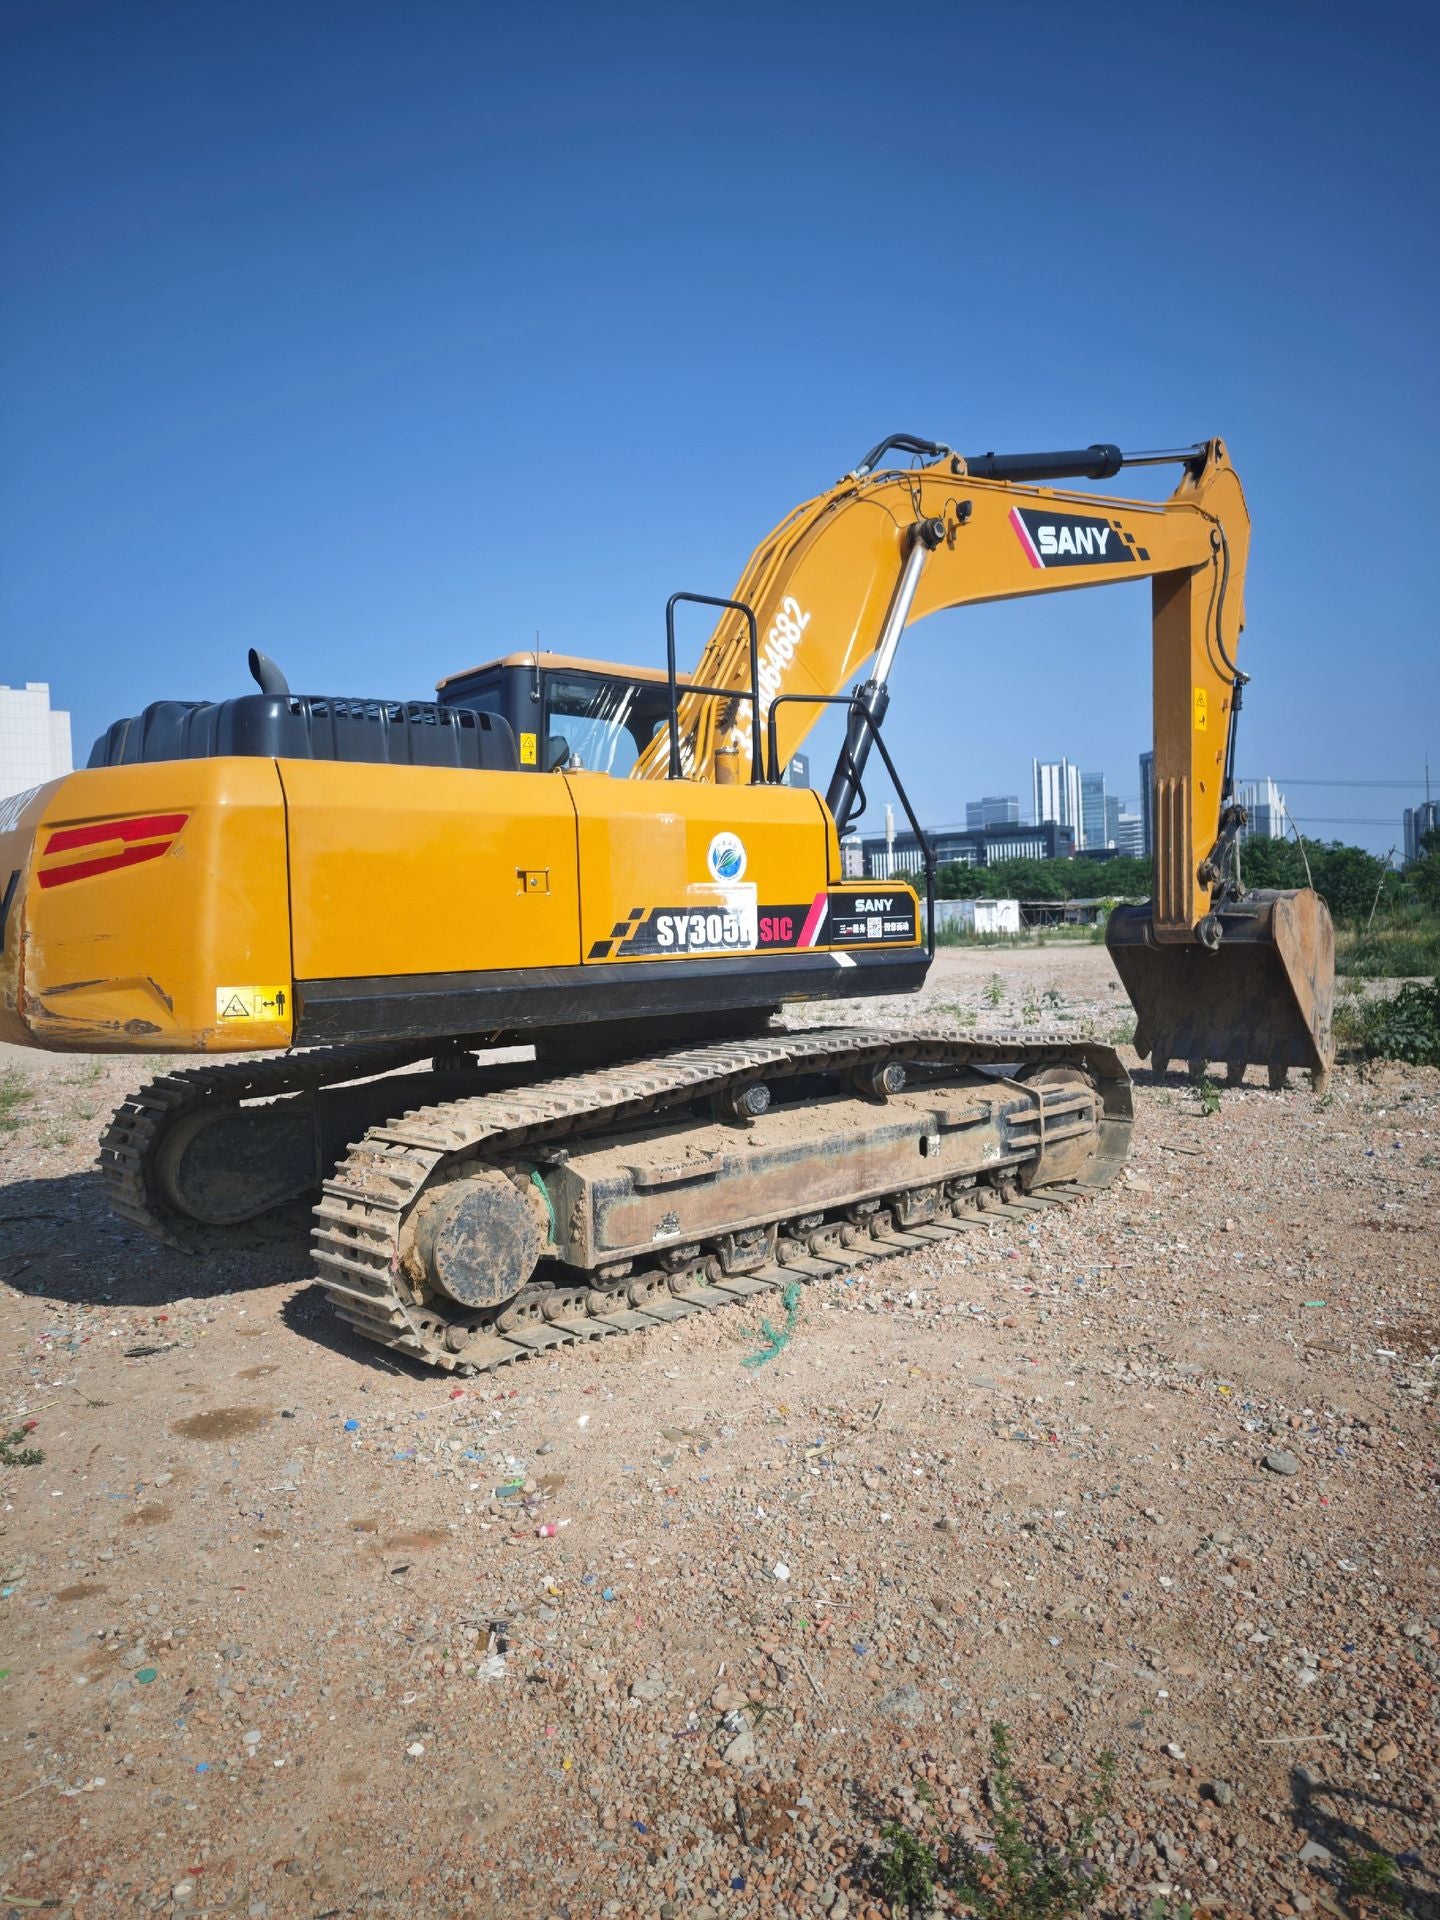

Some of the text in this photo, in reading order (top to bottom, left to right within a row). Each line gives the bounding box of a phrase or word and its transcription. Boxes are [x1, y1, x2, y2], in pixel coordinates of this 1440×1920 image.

[1037, 526, 1110, 554] SANY
[855, 899, 893, 912] SANY
[759, 917, 793, 941] SIC
